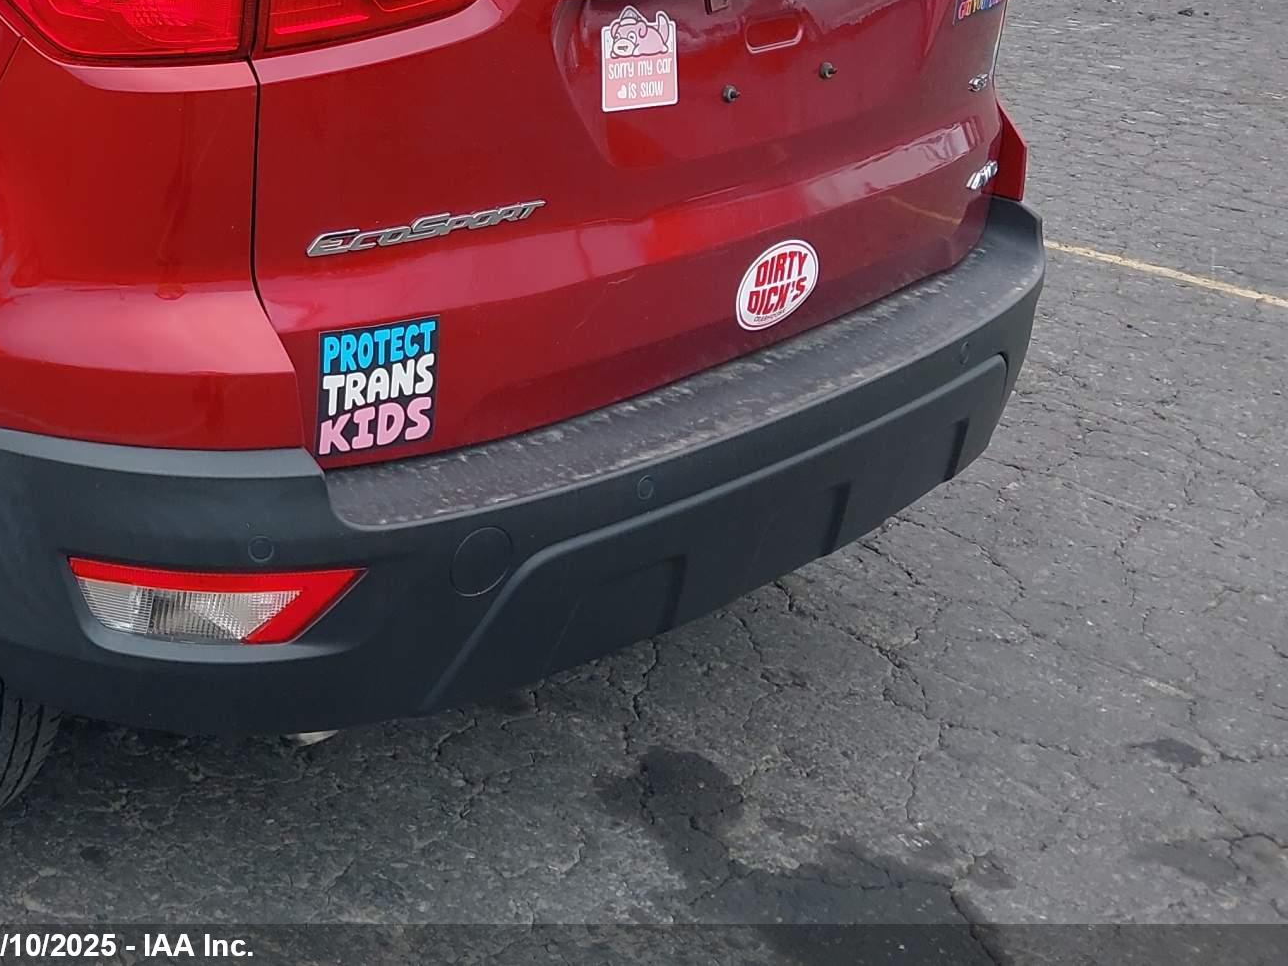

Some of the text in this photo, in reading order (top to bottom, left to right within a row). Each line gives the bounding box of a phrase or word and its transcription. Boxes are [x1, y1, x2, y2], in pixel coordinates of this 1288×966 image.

[608, 57, 673, 80] sorry my car
[628, 82, 638, 99] is
[755, 250, 808, 288] DIRTY
[747, 276, 808, 315] DICK'S
[323, 321, 436, 374] PROTECT
[323, 353, 435, 416] TRANS
[319, 397, 432, 455] KIDS
